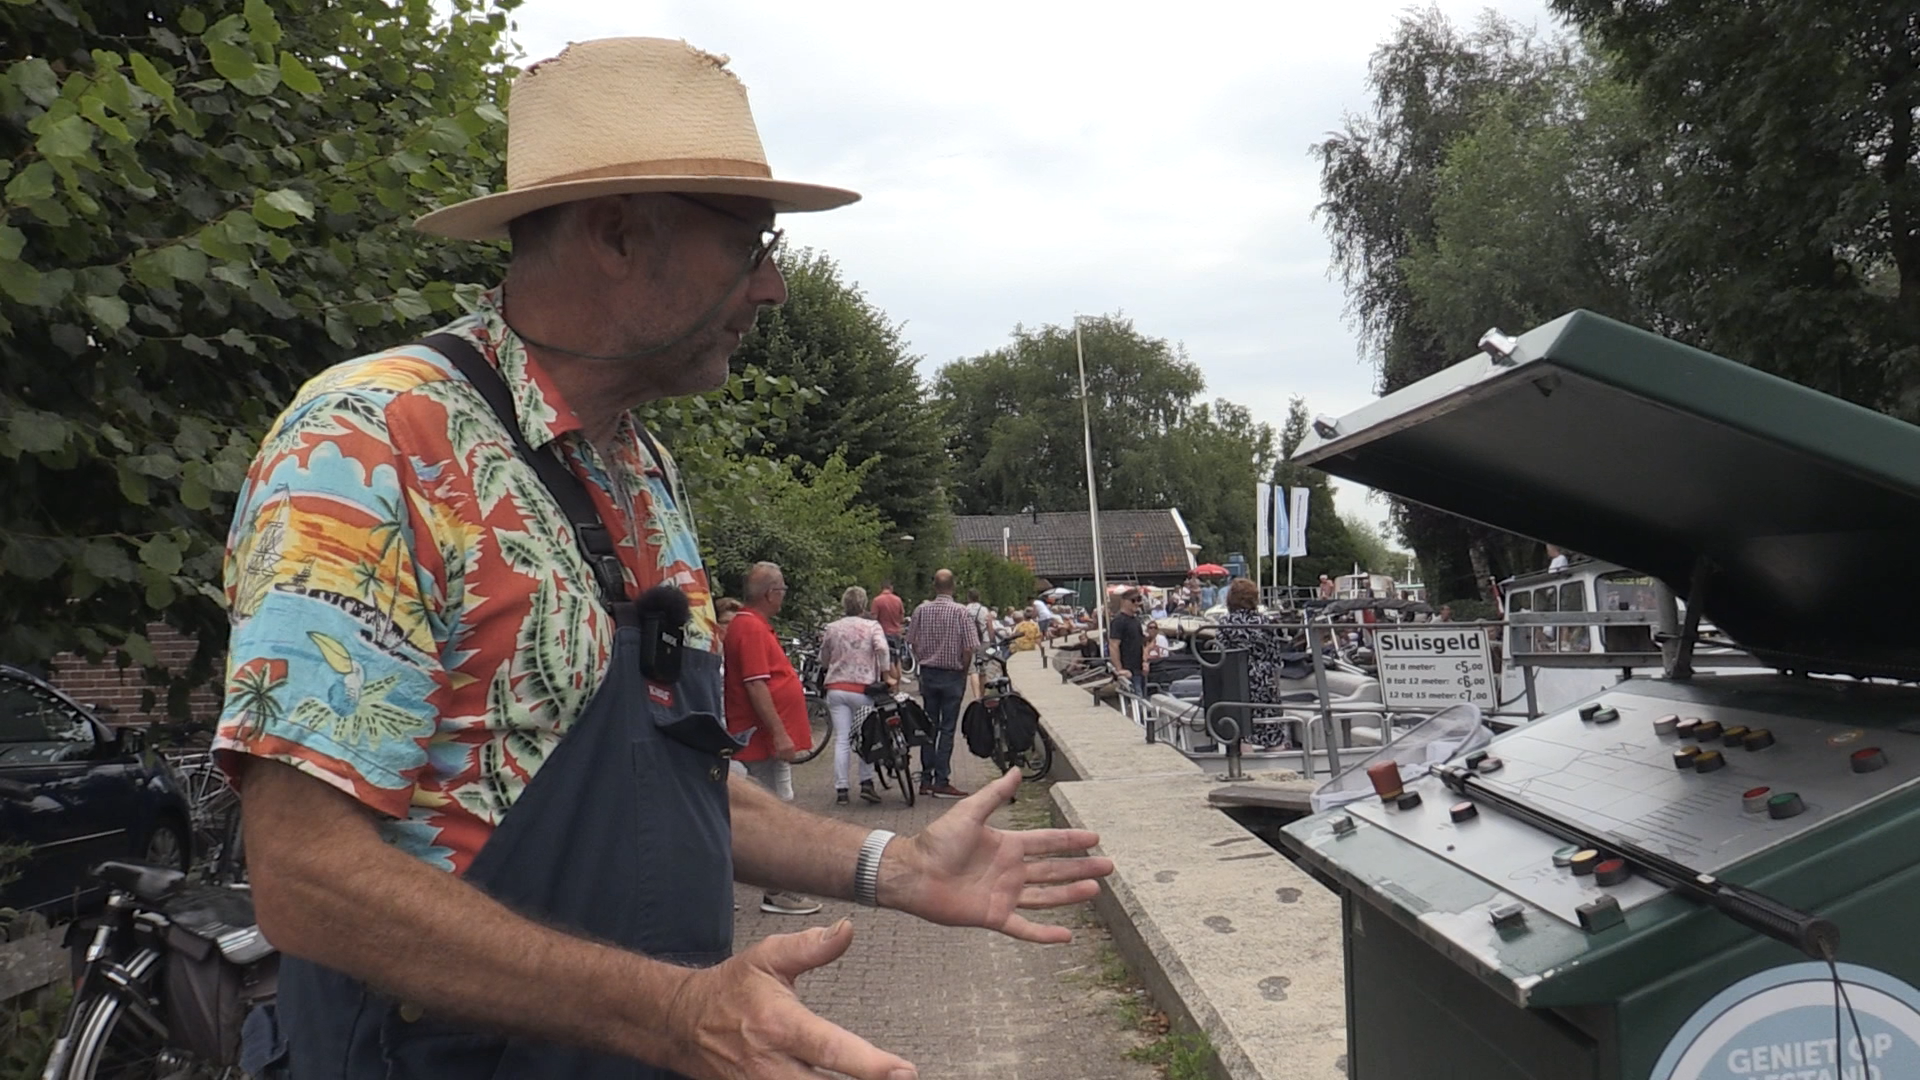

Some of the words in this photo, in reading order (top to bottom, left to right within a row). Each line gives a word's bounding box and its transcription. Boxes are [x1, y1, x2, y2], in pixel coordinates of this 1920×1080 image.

[1380, 633, 1481, 654] Sluisgeld
[1385, 663, 1398, 671] Tot
[1394, 677, 1406, 685] tot
[1409, 677, 1419, 685] 12
[1389, 691, 1399, 699] 12
[1401, 691, 1413, 699] tot
[1416, 691, 1426, 699] 15
[1727, 1037, 1838, 1074] GENIET
[1847, 1032, 1893, 1062] OP
